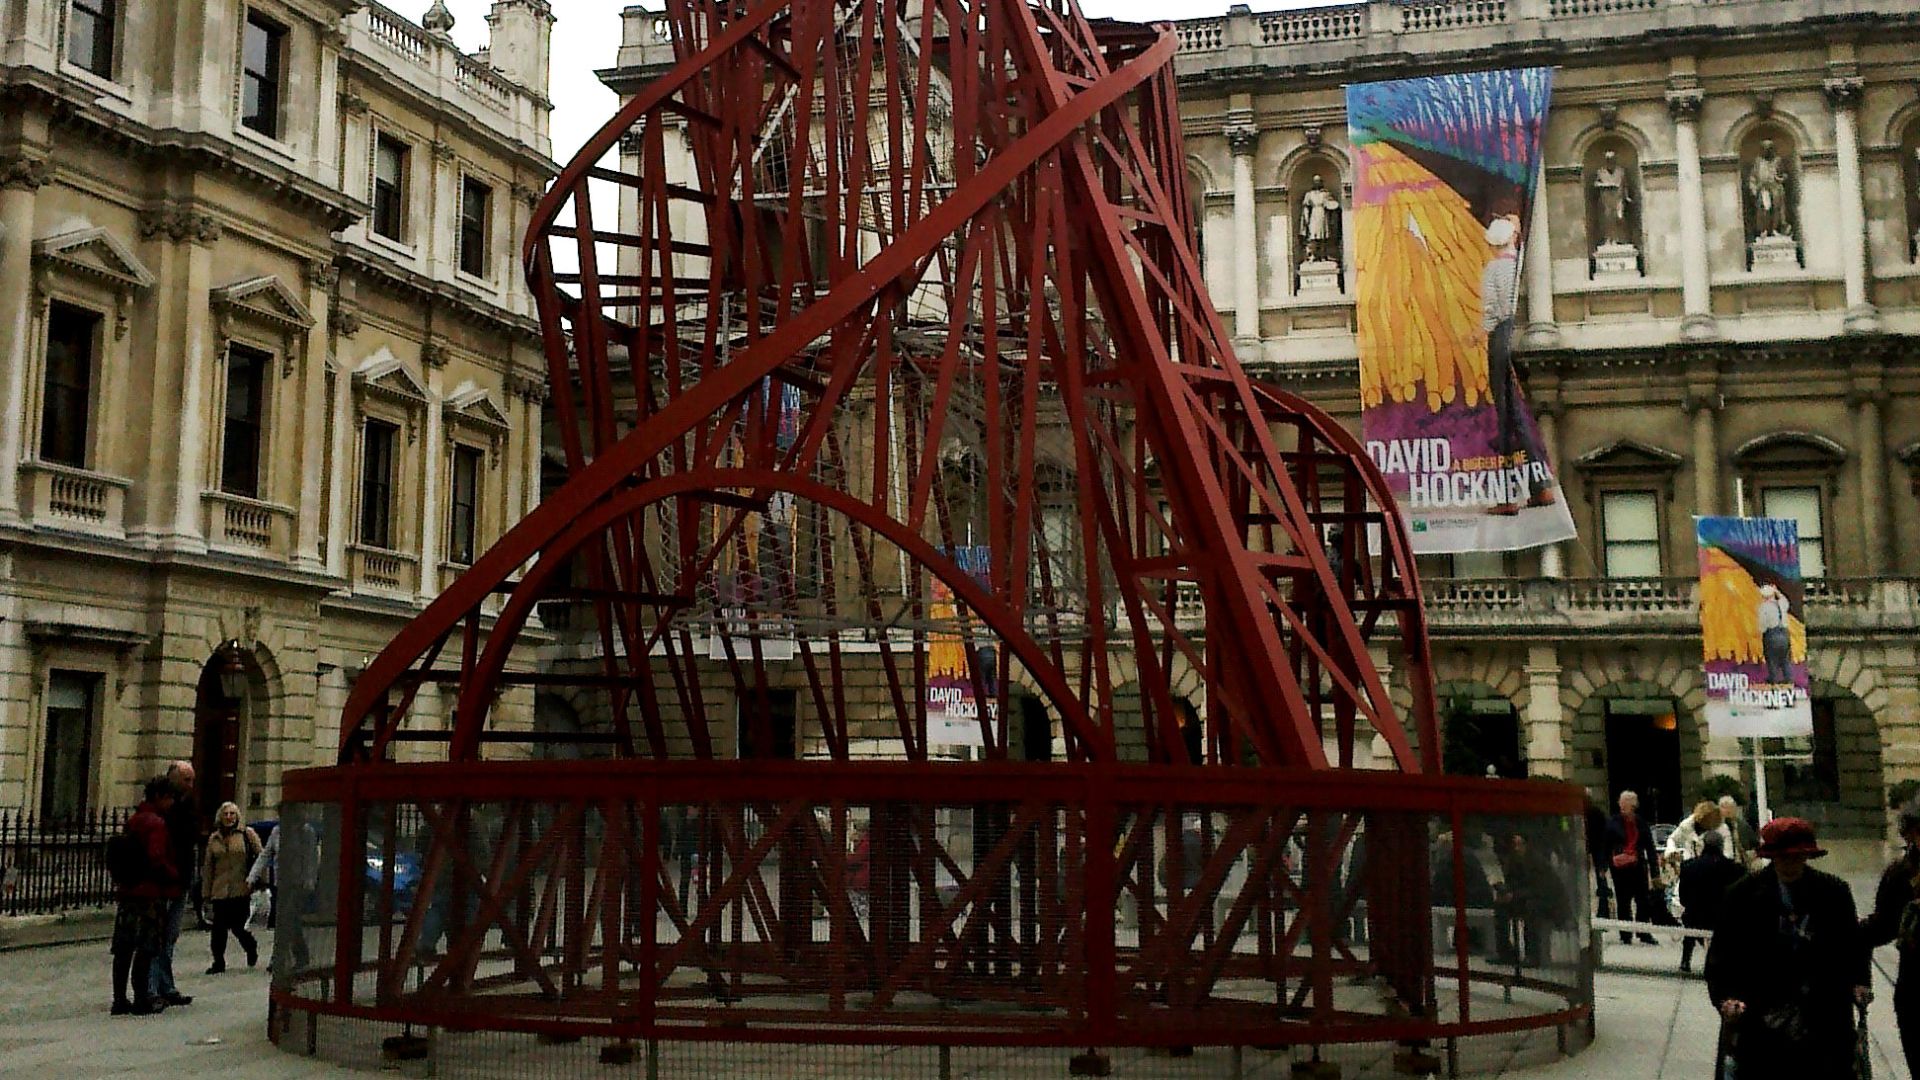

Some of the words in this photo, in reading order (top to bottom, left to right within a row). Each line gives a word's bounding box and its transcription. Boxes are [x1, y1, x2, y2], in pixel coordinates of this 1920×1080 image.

[1367, 437, 1450, 474] DAVID
[1410, 465, 1531, 508] HOCKNEY
[1707, 672, 1748, 690] DAVID
[930, 687, 962, 702] DAVID
[1729, 687, 1794, 706] HOCKNEY
[945, 702, 998, 718] HOCKY
